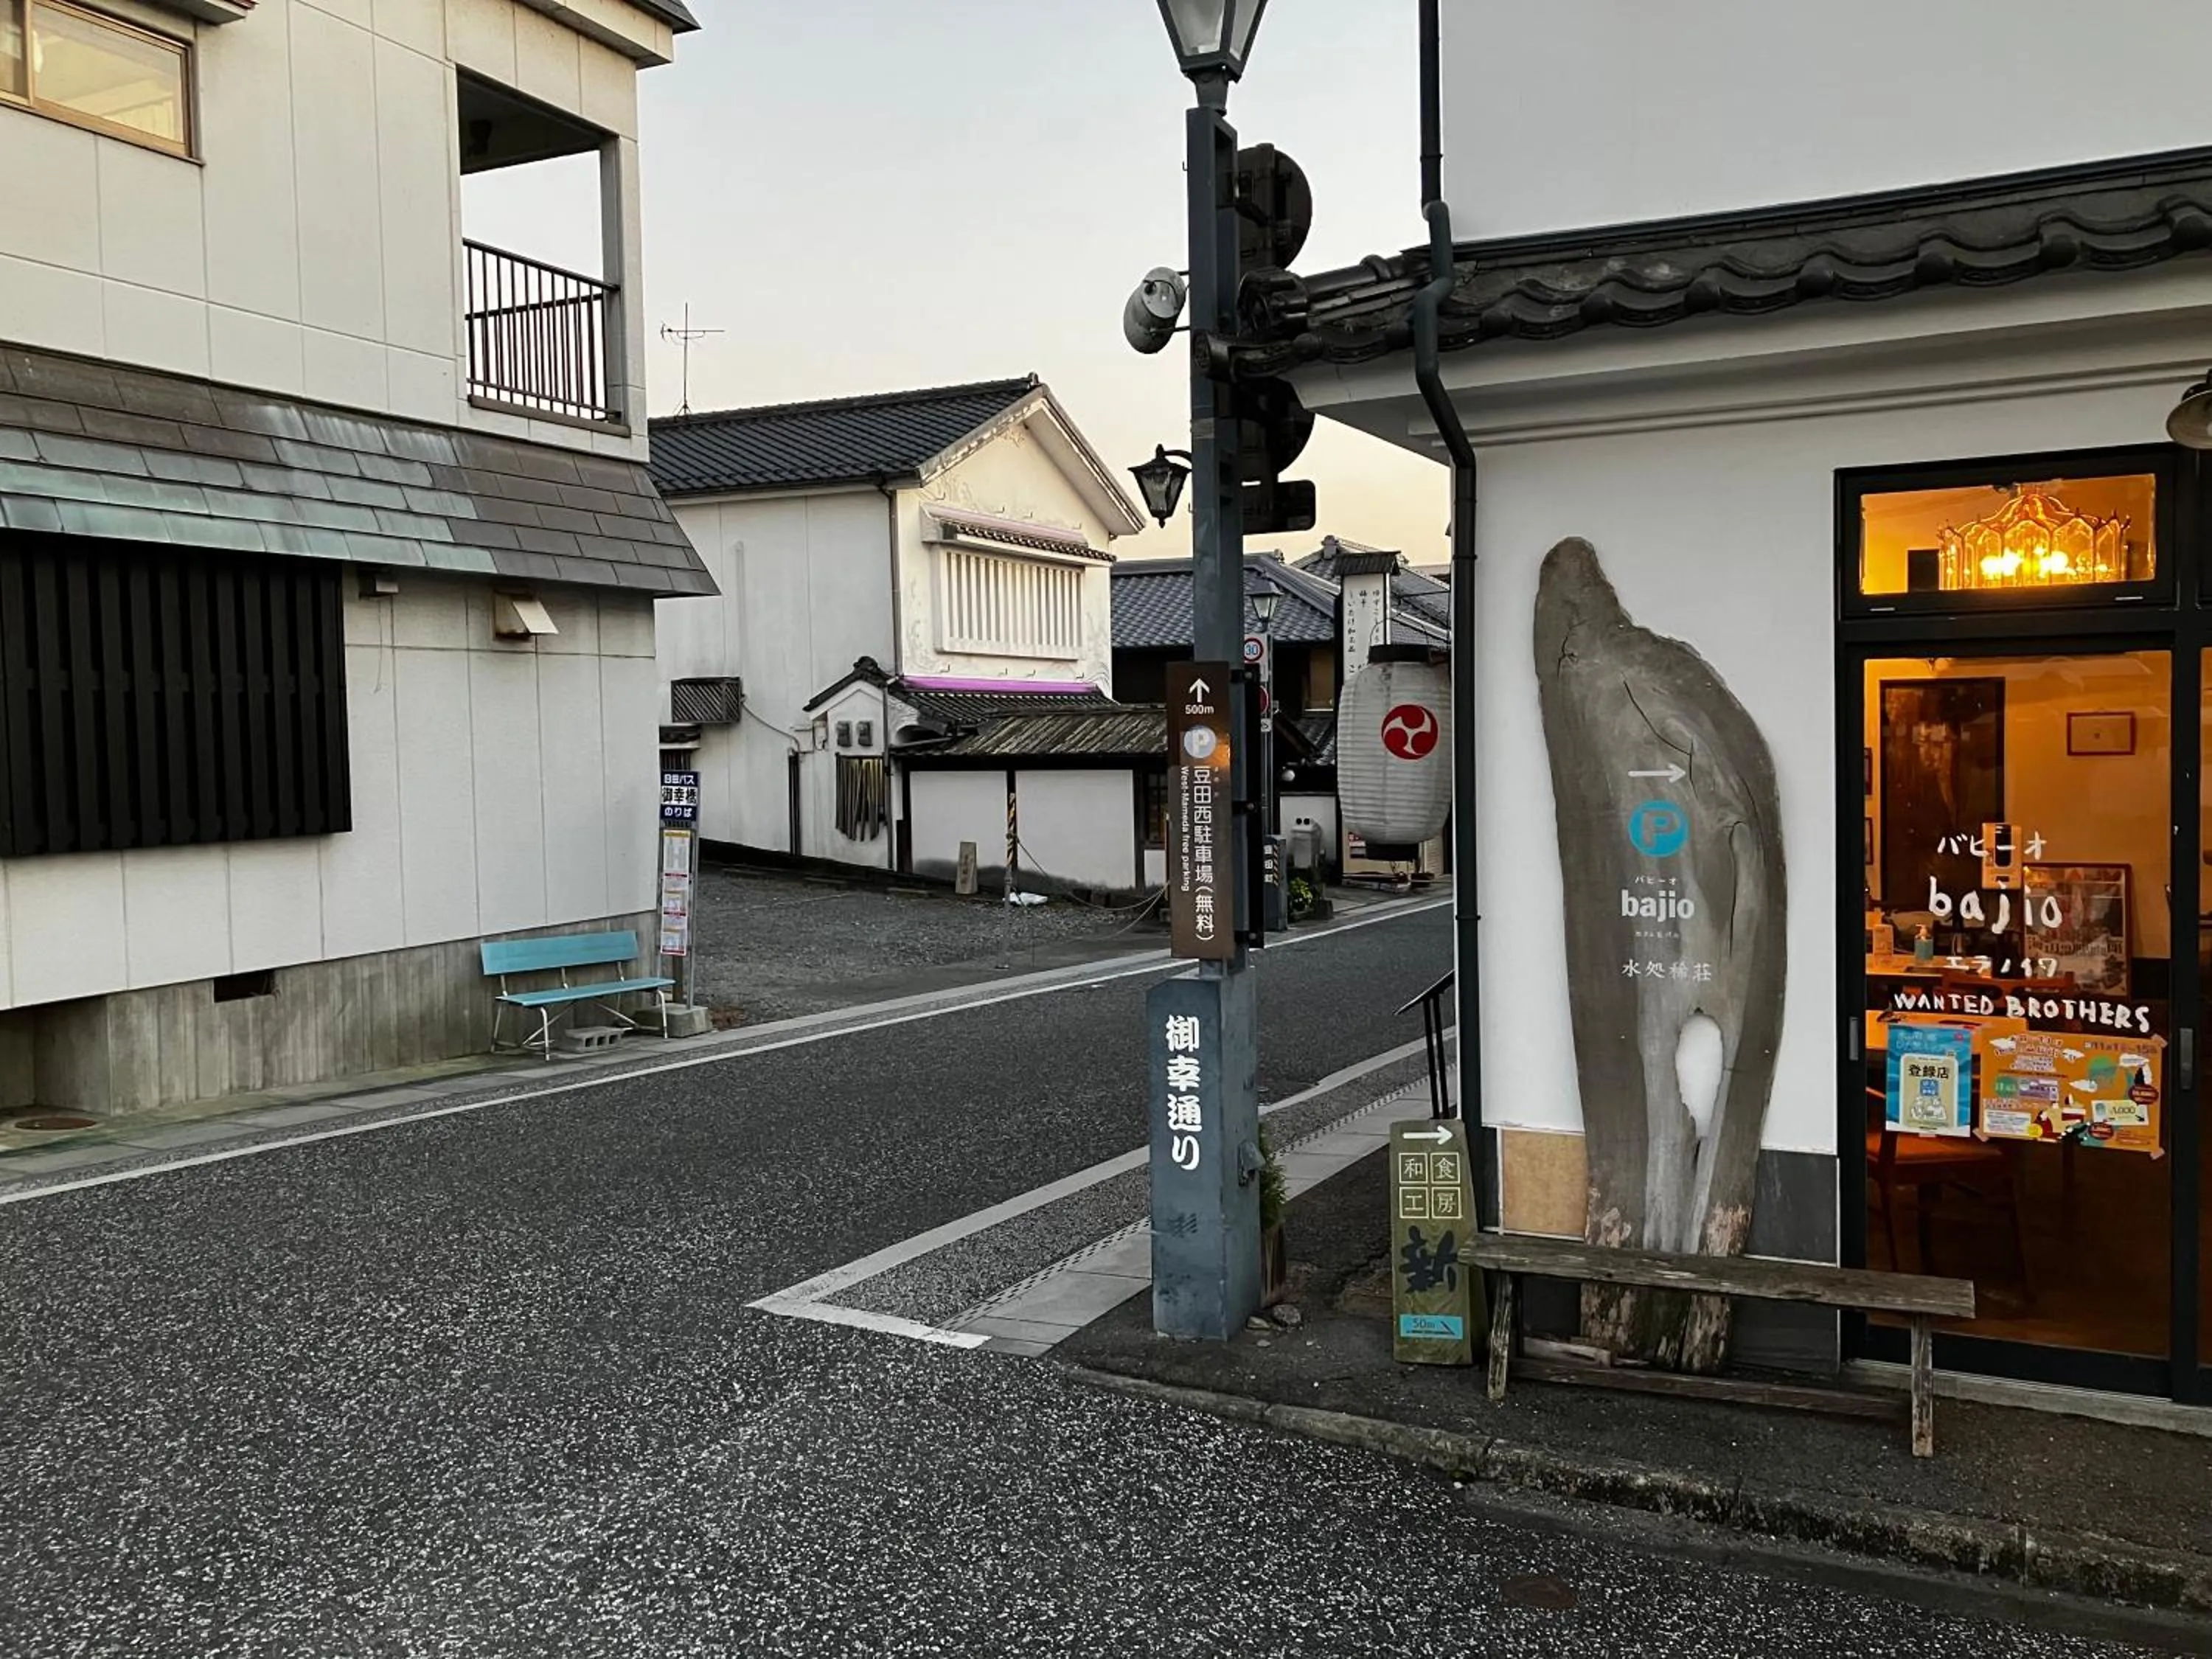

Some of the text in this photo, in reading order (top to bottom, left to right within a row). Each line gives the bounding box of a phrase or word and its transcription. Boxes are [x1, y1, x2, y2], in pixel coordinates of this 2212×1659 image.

[1245, 644, 1259, 655] 30
[1185, 704, 1214, 714] 500m
[664, 807, 692, 818] のりば
[1181, 834, 1191, 853] free
[1937, 830, 2048, 861] バヒーオ
[1180, 855, 1190, 892] parking
[1621, 889, 1695, 922] bajio
[1928, 875, 2063, 935] bajio
[1893, 993, 2150, 1033] WANTED BROTHERS
[1908, 1063, 1950, 1079] 登録店
[1166, 1014, 1203, 1171] 御幸通り
